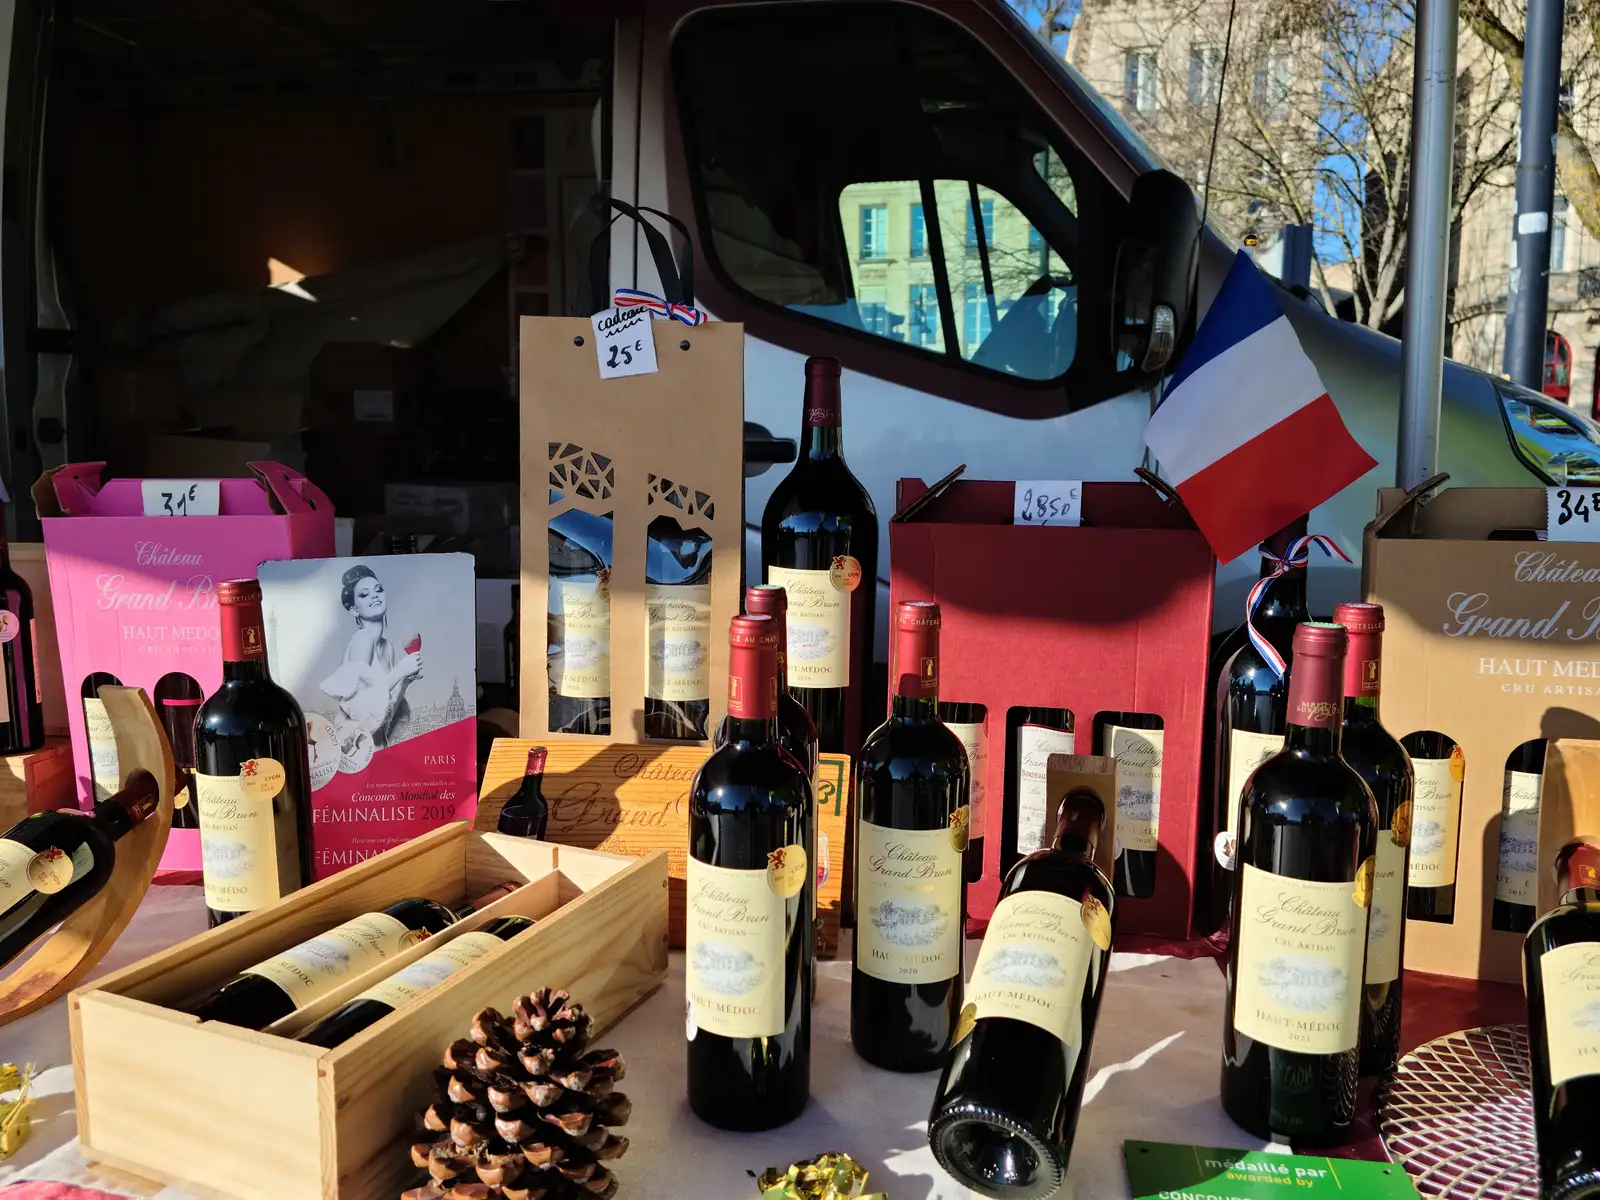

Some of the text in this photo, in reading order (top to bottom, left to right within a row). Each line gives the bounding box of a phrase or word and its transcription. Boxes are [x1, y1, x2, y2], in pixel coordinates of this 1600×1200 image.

[598, 305, 649, 332] cadeau
[606, 340, 643, 368] 25€
[134, 541, 204, 566] Château
[96, 574, 177, 611] Grand
[787, 579, 826, 595] Château
[808, 595, 840, 608] Brun
[649, 608, 708, 621] Grand Brun
[1442, 592, 1573, 638] Grand
[123, 625, 168, 640] HAUT
[744, 635, 755, 643] AU
[1478, 657, 1548, 676] HAUT
[1501, 683, 1536, 693] CRU
[424, 755, 456, 765] PARIS
[968, 748, 987, 760] Brun
[1114, 751, 1149, 768] Grand
[265, 773, 281, 781] LYON
[351, 789, 456, 803] Concours Mondial des
[1416, 786, 1452, 800] Brun
[218, 805, 259, 819] Brun
[312, 805, 456, 824] FÉMINALISE 2019
[551, 781, 673, 833] Grand
[884, 841, 939, 861] Château
[868, 855, 953, 879] Grand Brun
[698, 877, 750, 904] Château
[723, 905, 770, 922] Brun
[1011, 901, 1064, 920] Château
[1278, 892, 1341, 918] Château
[995, 915, 1080, 942] Grand Brun
[1255, 905, 1356, 936] Grand Brun
[713, 925, 747, 937] ARTISAN
[1003, 931, 1056, 943] CRU ARTISAN
[1275, 936, 1336, 953] CRU ARTISAN
[1288, 1033, 1311, 1042] 2021
[1205, 1155, 1328, 1177] médaillé par
[1226, 1173, 1314, 1188] awarded by
[1158, 1191, 1254, 1200] CONCOU
